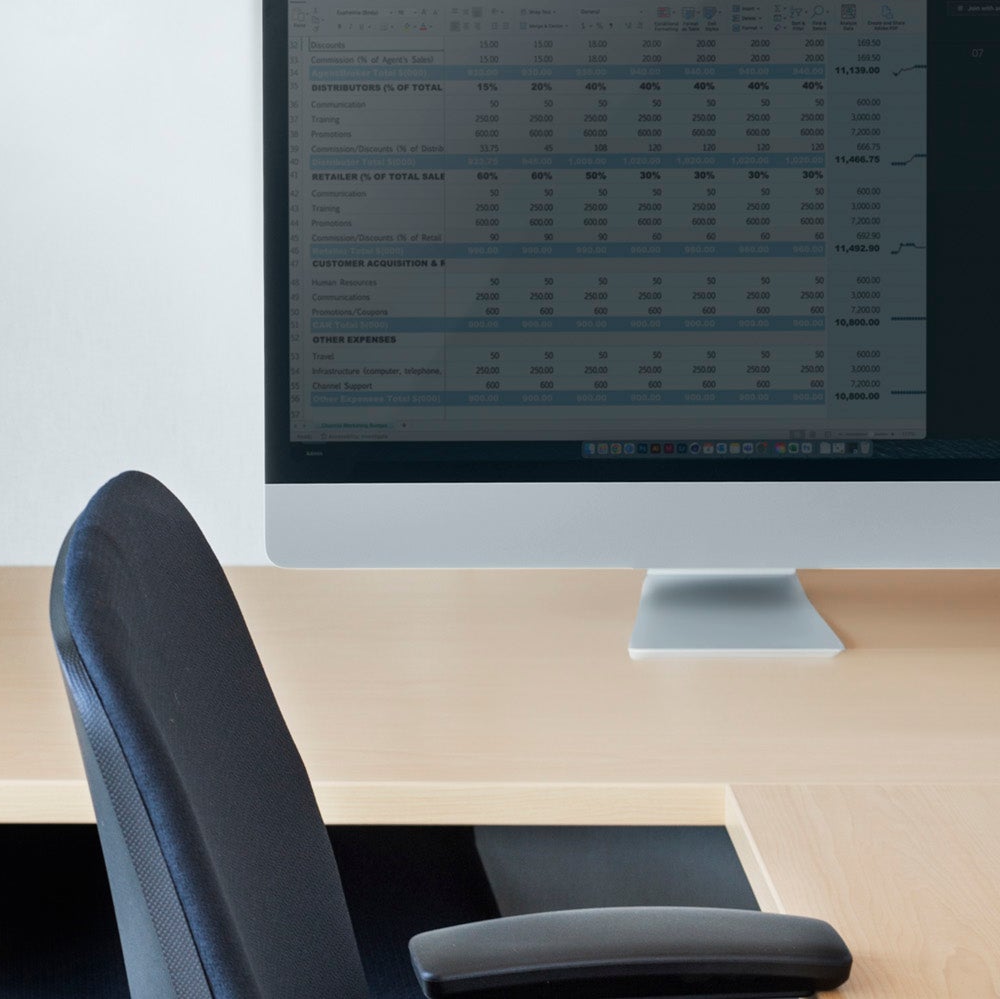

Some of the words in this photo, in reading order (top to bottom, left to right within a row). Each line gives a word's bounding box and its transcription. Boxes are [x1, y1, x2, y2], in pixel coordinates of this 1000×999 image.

[310, 40, 345, 49] Discounts
[480, 40, 499, 48] 15.00
[534, 40, 553, 48] 15.00
[588, 40, 608, 48] 18.00
[642, 40, 662, 48] 20.00
[696, 39, 716, 48] 20.00
[750, 39, 771, 47] 20.00
[805, 39, 824, 47] 20.00
[858, 39, 881, 47] 169.50
[310, 56, 355, 64] Commission
[382, 56, 408, 65] Agent's
[480, 55, 499, 63] 15.00
[534, 55, 554, 63] 15.00
[588, 55, 608, 63] 18.00
[642, 54, 662, 63] 20.00
[696, 54, 716, 63] 20.00
[750, 54, 770, 62] 20.00
[805, 54, 825, 62] 20.00
[858, 54, 881, 62] 169.50
[835, 66, 880, 75] 11,139.00
[312, 84, 381, 92] DISTRIBUTORS
[412, 83, 443, 91] TOTAL
[477, 83, 498, 91] 15%
[531, 82, 552, 91] 20%
[585, 82, 606, 91] 40%
[639, 82, 661, 91] 40%
[693, 82, 715, 90] 40%
[748, 81, 769, 90] 40%
[802, 81, 823, 90] 40%
[311, 101, 366, 109] Communication
[857, 98, 881, 106] 600.00
[311, 115, 340, 125] Training
[475, 114, 499, 123] 250.00
[529, 114, 554, 122] 250.00
[584, 114, 608, 122] 250.00
[638, 114, 662, 122] 250.00
[692, 113, 716, 122] 250.00
[746, 113, 771, 122] 250.00
[800, 113, 824, 121] 250.00
[311, 130, 352, 138] Promotions
[311, 145, 393, 153] Commission/Discounts
[480, 144, 499, 152] 33.75
[544, 144, 554, 152] 45
[594, 143, 608, 152] 108
[648, 143, 662, 152] 120
[703, 143, 716, 152] 120
[757, 143, 771, 151] 120
[811, 143, 825, 151] 120
[857, 142, 881, 151] 666.75
[835, 155, 880, 164] 11,466.75
[312, 173, 358, 181] RETAILER
[477, 172, 498, 180] 60%
[531, 171, 552, 180] 60%
[586, 171, 607, 180] 50%
[640, 171, 661, 180] 30%
[694, 171, 715, 179] 30%
[748, 170, 769, 179] 30%
[802, 170, 824, 179] 30%
[311, 189, 367, 198] Communication
[857, 187, 881, 195] 600.00
[312, 204, 341, 214] Training
[311, 219, 352, 227] Promotions
[311, 233, 394, 244] Commission/Discounts
[489, 233, 499, 241] 90
[544, 233, 553, 241] 90
[598, 233, 608, 241] 90
[652, 232, 662, 240] 60
[706, 232, 716, 240] 60
[760, 232, 771, 240] 60
[815, 232, 824, 240] 60
[856, 232, 881, 240] 692.90
[835, 244, 880, 253] 11,492.90
[312, 259, 365, 268] CUSTOMER
[367, 259, 428, 267] ACQUISITION
[311, 279, 337, 287] Human
[339, 278, 378, 287] Resources
[856, 276, 880, 284] 600.00
[312, 292, 371, 302] Communications
[312, 307, 388, 318] Promotions/Coupons
[834, 318, 880, 327] 10,800.00
[312, 352, 335, 360] Travel
[856, 350, 880, 358] 600.00
[312, 367, 360, 375] Infrastructure
[312, 382, 341, 390] Channel
[344, 382, 373, 392] Support
[486, 381, 500, 390] 600
[540, 380, 554, 389] 600
[594, 380, 608, 389] 600
[648, 380, 662, 389] 600
[702, 380, 716, 389] 600
[756, 380, 770, 388] 600
[810, 380, 824, 388] 600
[835, 392, 880, 401] 10,800.00
